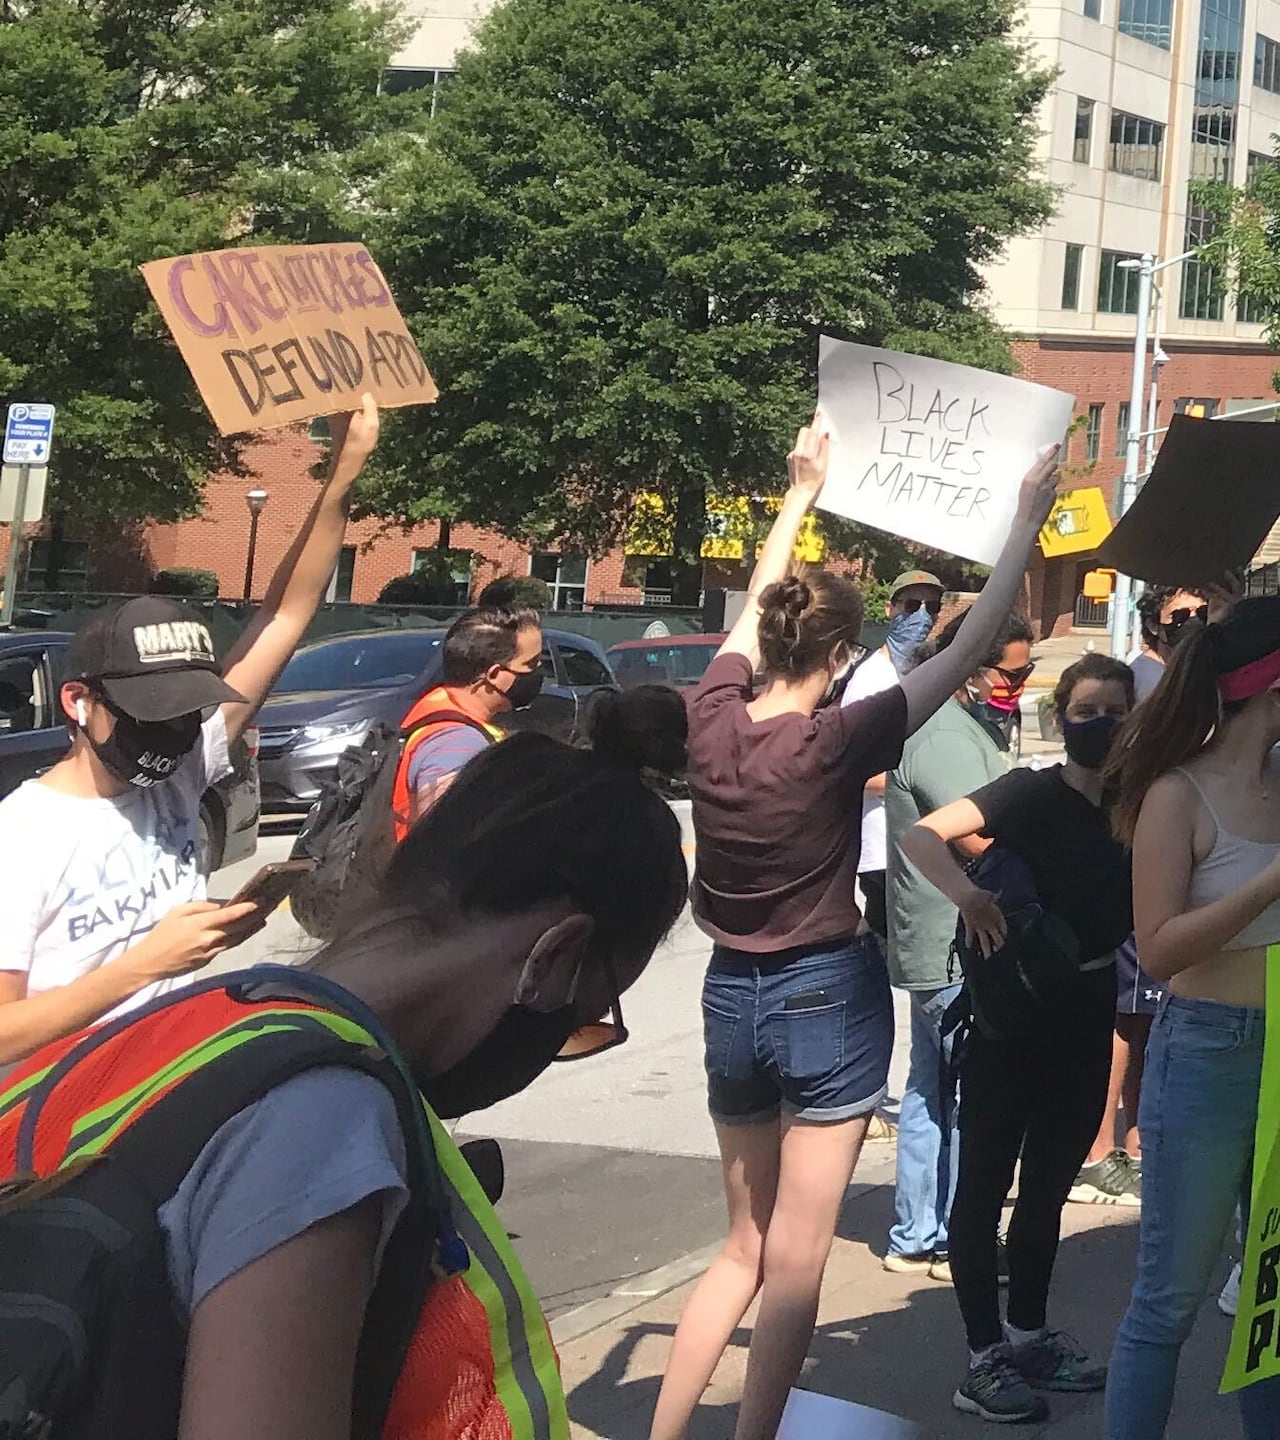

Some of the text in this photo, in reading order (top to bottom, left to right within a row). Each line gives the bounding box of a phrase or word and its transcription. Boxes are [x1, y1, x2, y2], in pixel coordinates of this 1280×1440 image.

[167, 250, 289, 339] CARE
[306, 247, 391, 314] CAGES
[220, 325, 426, 418] DEFUND APD
[872, 360, 991, 441] BLACK
[880, 426, 986, 475] LIVES
[857, 462, 991, 520] MATTER
[133, 621, 214, 655] MARY'S
